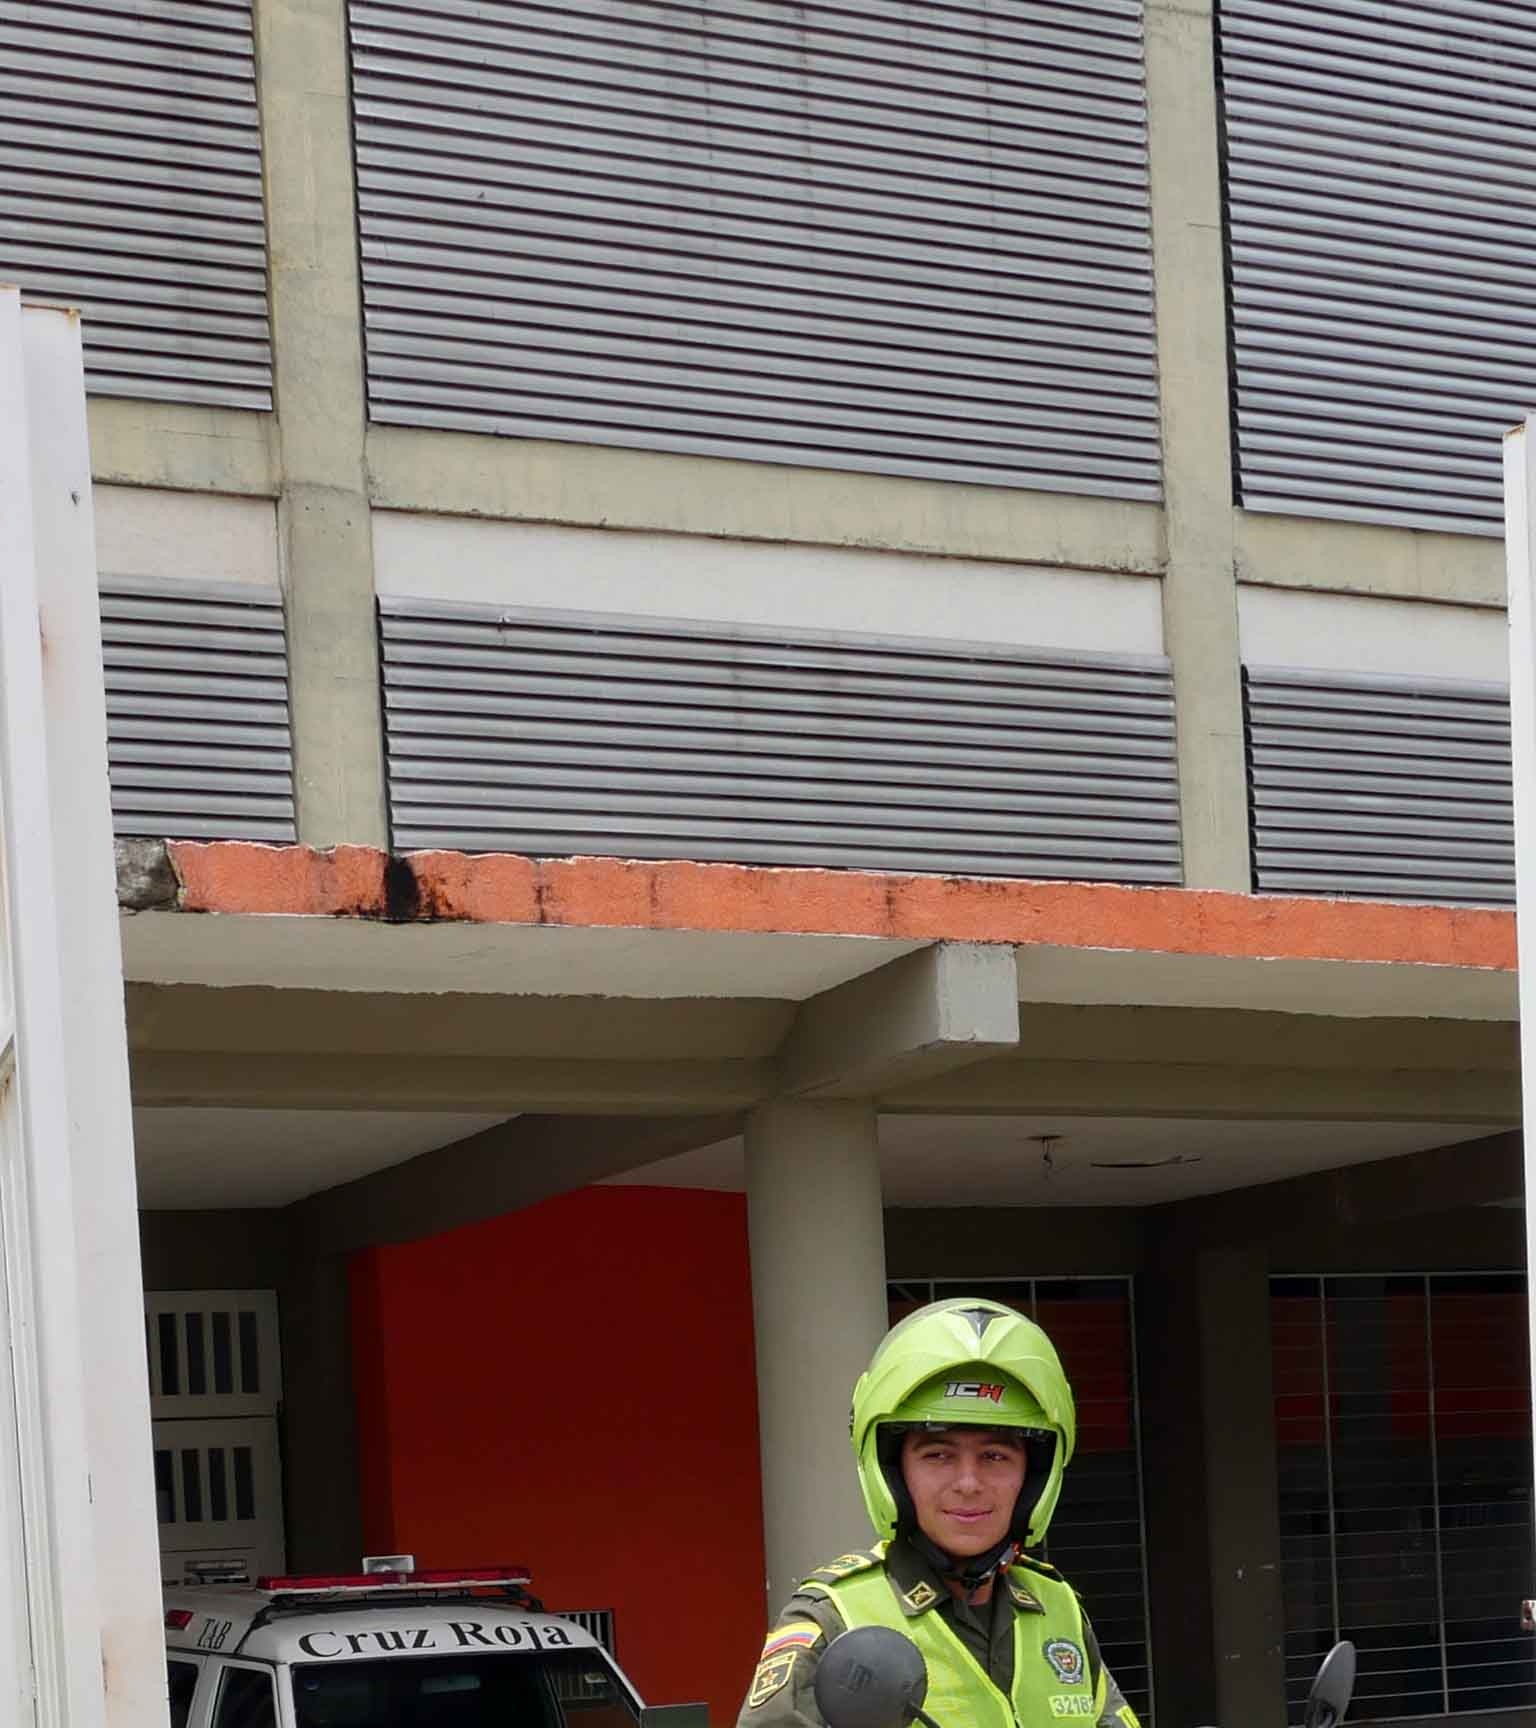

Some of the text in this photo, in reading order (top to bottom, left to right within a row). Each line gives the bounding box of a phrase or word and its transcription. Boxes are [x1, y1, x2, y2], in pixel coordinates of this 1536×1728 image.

[197, 1618, 233, 1649] TAB
[297, 1621, 574, 1658] Cruz Roja
